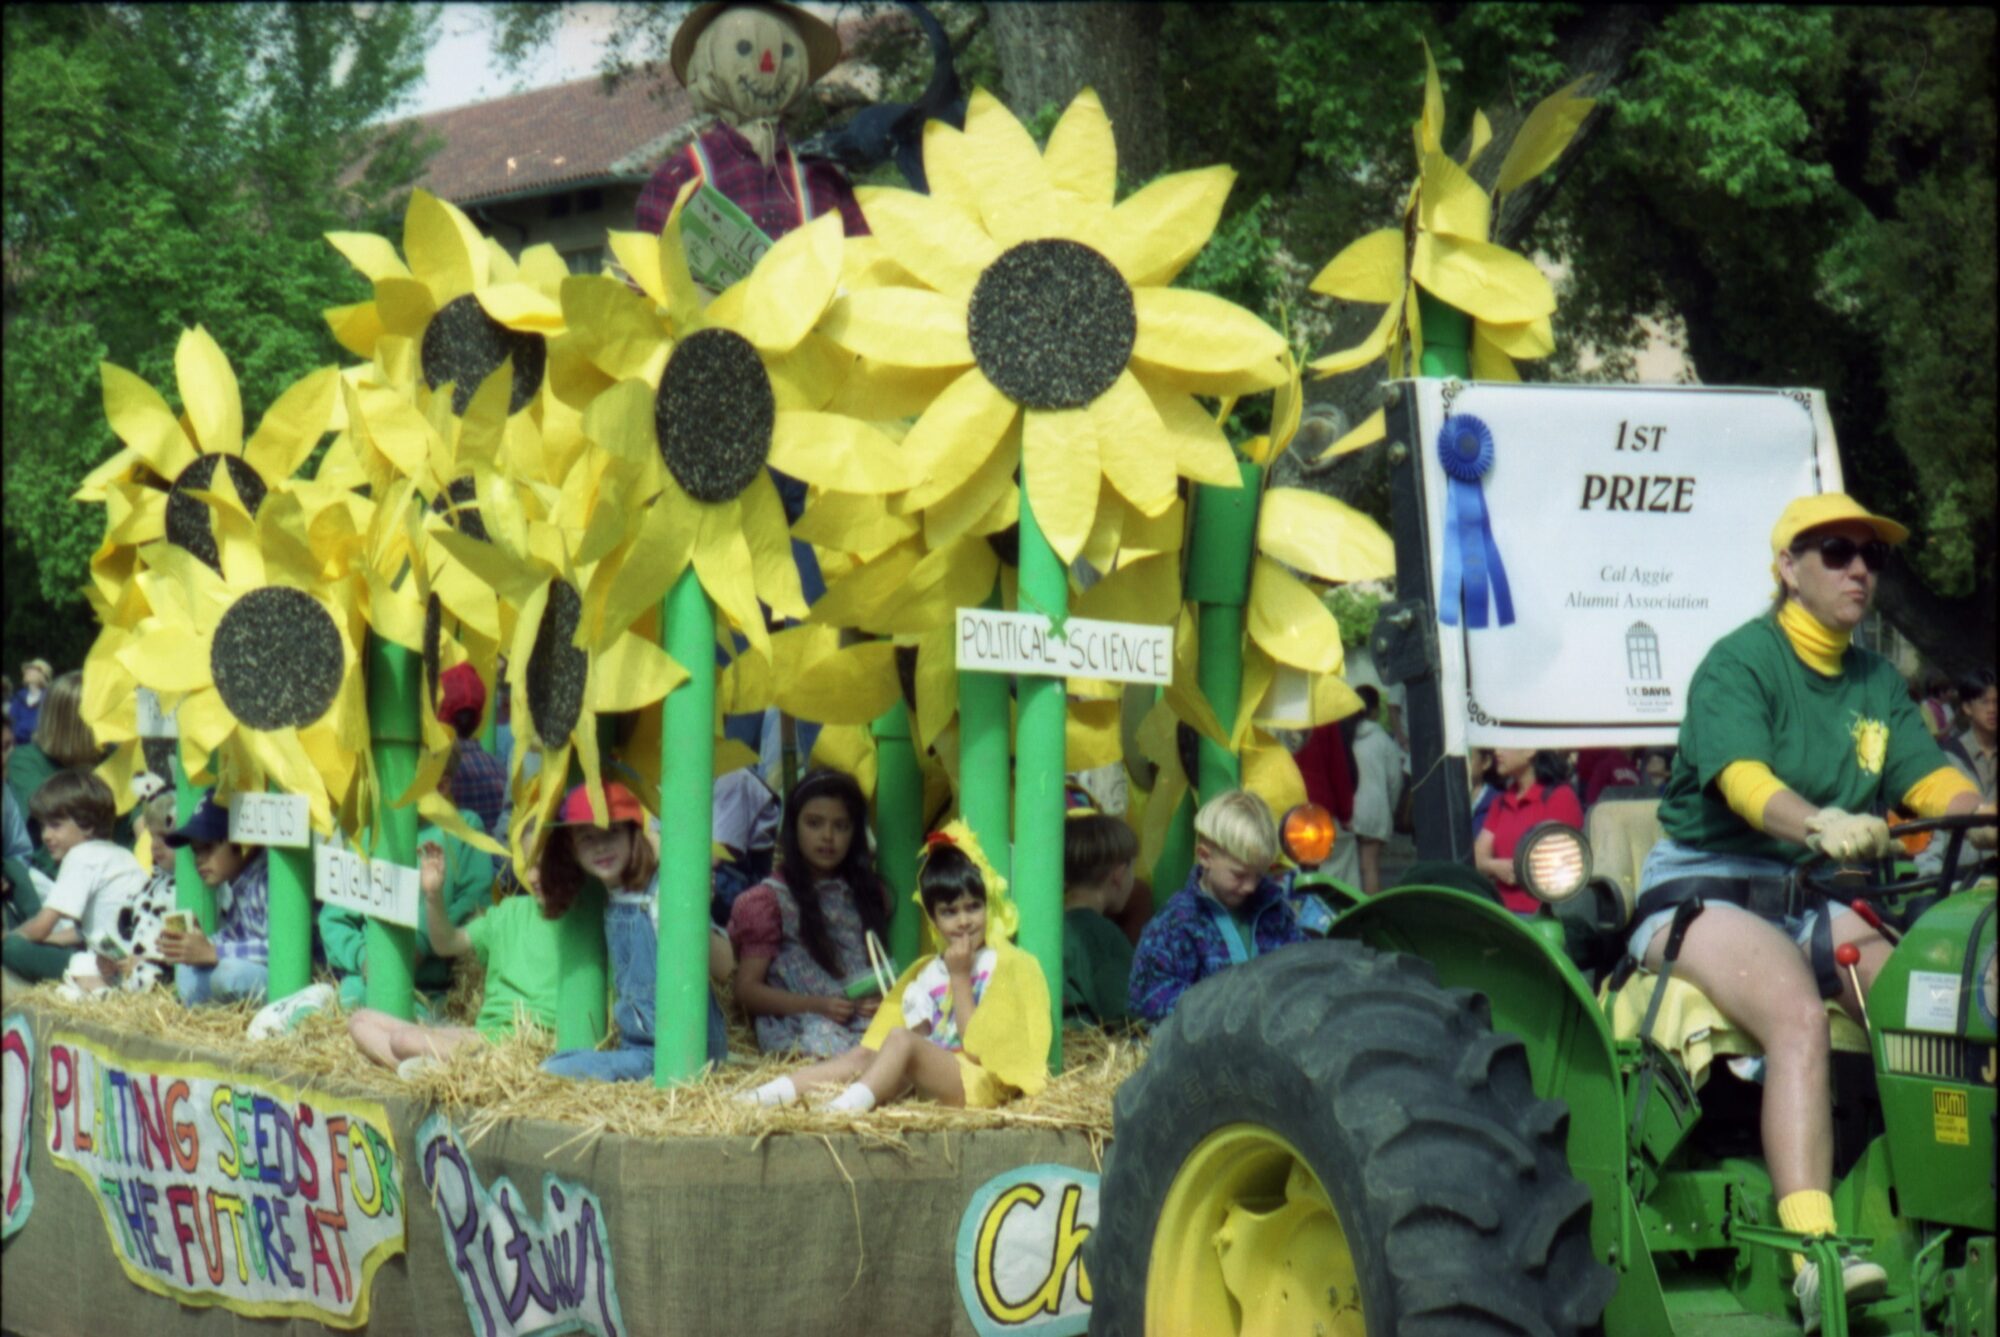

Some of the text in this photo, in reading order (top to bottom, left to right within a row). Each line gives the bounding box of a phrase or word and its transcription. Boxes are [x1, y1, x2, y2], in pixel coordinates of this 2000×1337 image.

[1614, 420, 1667, 452] 1ST
[1579, 474, 1696, 514] PRIZE
[1599, 565, 1674, 588] Cal Aggie
[1564, 590, 1709, 610] Alumni Association
[961, 616, 1168, 677] POLITICAL SCIENCE
[210, 1085, 319, 1200] SEEDS
[326, 1116, 400, 1218] FOR
[100, 1172, 353, 1304] THE FUTURE AT
